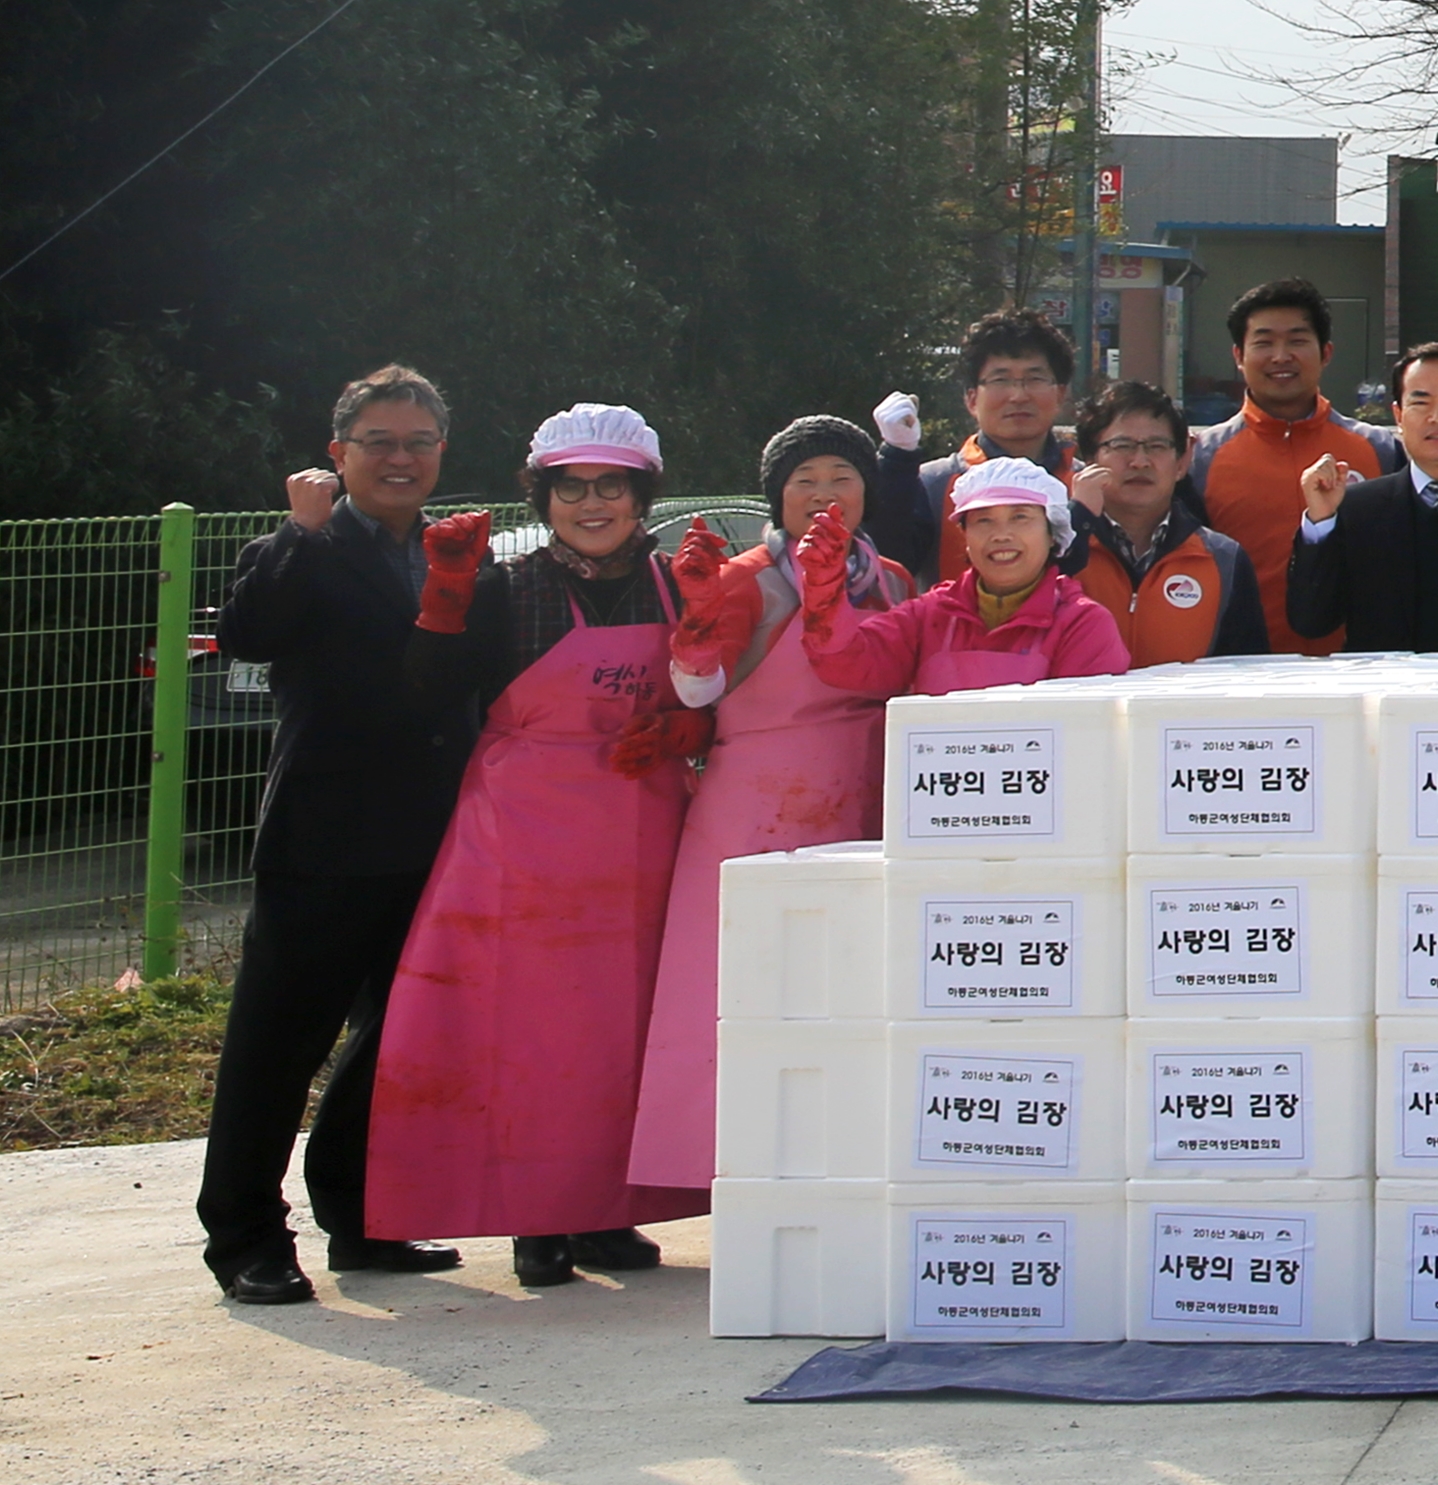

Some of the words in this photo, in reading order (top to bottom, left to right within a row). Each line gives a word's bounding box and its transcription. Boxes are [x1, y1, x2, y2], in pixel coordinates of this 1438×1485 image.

[980, 743, 1014, 754] 겨울나기
[913, 771, 985, 797] 사랑의
[1001, 769, 1050, 795] 김장
[930, 814, 1032, 828] 하동군여성단체협의회
[1224, 900, 1259, 912] 겨울나기
[1157, 928, 1230, 955] 사랑의
[1246, 927, 1296, 953] 김장
[1175, 972, 1278, 987] 하동군여성단체협의회
[997, 1071, 1032, 1083] 겨울나기
[927, 1096, 1000, 1123] 사랑의
[1017, 1100, 1067, 1127] 김장
[942, 1141, 1046, 1158] 하동군여성단체협의회
[1229, 1229, 1264, 1241] 겨울나기
[1159, 1254, 1233, 1282] 사랑의
[1250, 1258, 1300, 1285] 김장
[1175, 1300, 1279, 1316] 하동군여성단체협의회
